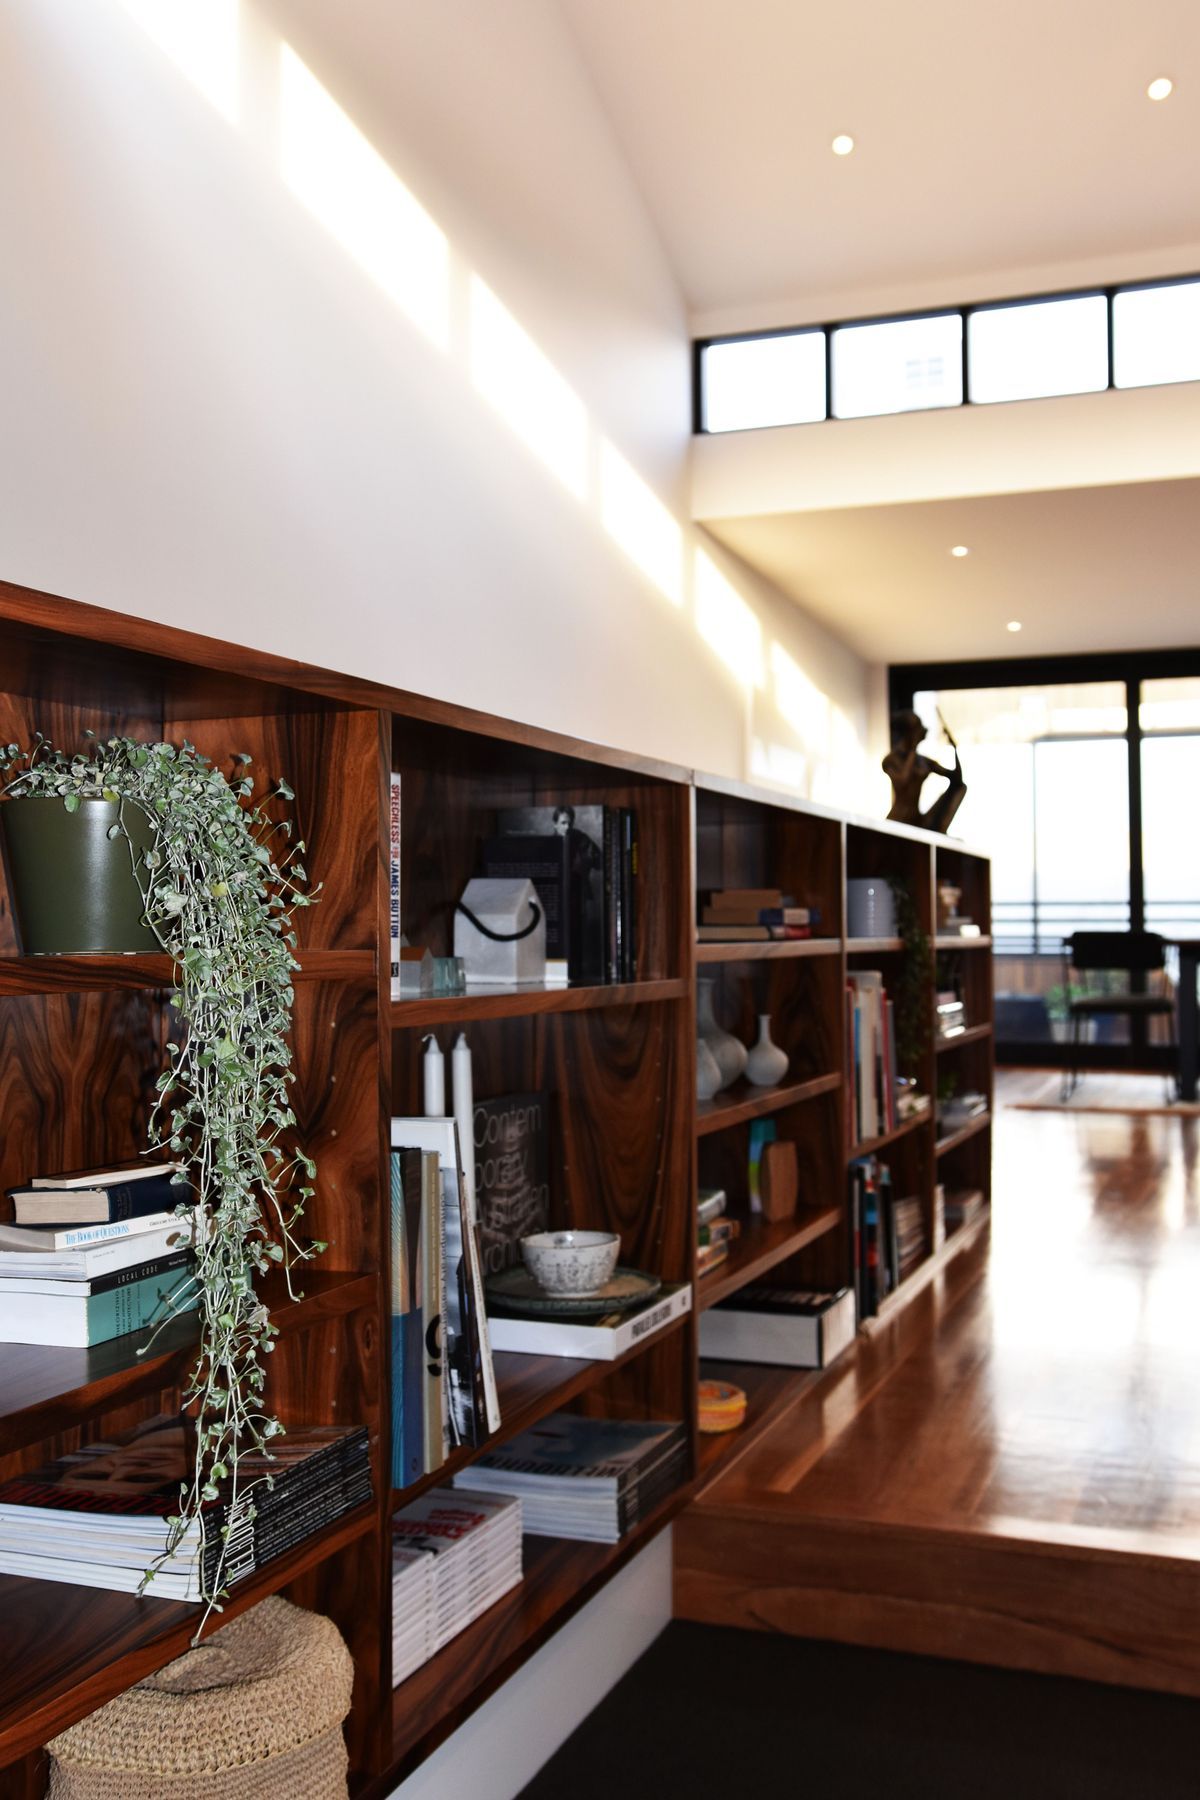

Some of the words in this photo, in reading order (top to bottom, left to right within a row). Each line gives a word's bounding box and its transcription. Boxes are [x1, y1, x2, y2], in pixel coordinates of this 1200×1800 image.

[390, 784, 400, 843] SPEECHLESS
[390, 860, 400, 896] JAMES
[390, 899, 399, 939] BUTTON
[473, 1104, 542, 1147] Contem
[117, 1271, 138, 1284] LOCAL
[141, 1264, 158, 1277] CODE
